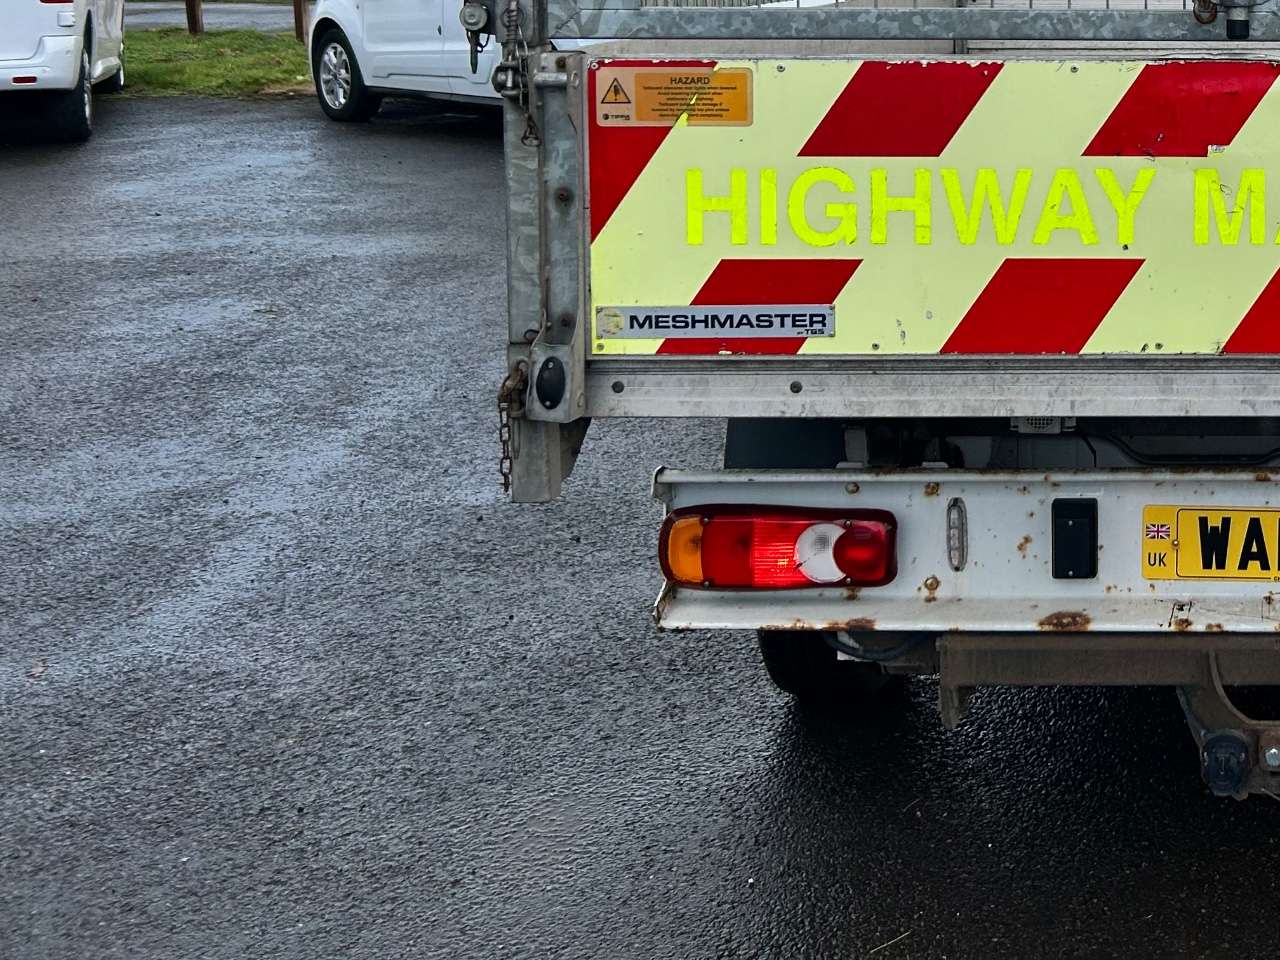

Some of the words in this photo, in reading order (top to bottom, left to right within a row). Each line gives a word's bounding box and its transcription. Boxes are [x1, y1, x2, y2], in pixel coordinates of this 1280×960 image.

[670, 76, 710, 85] HAZARD
[684, 166, 1156, 248] HIGHWAY
[629, 313, 827, 330] MESHMASTER
[1147, 551, 1168, 568] UK
